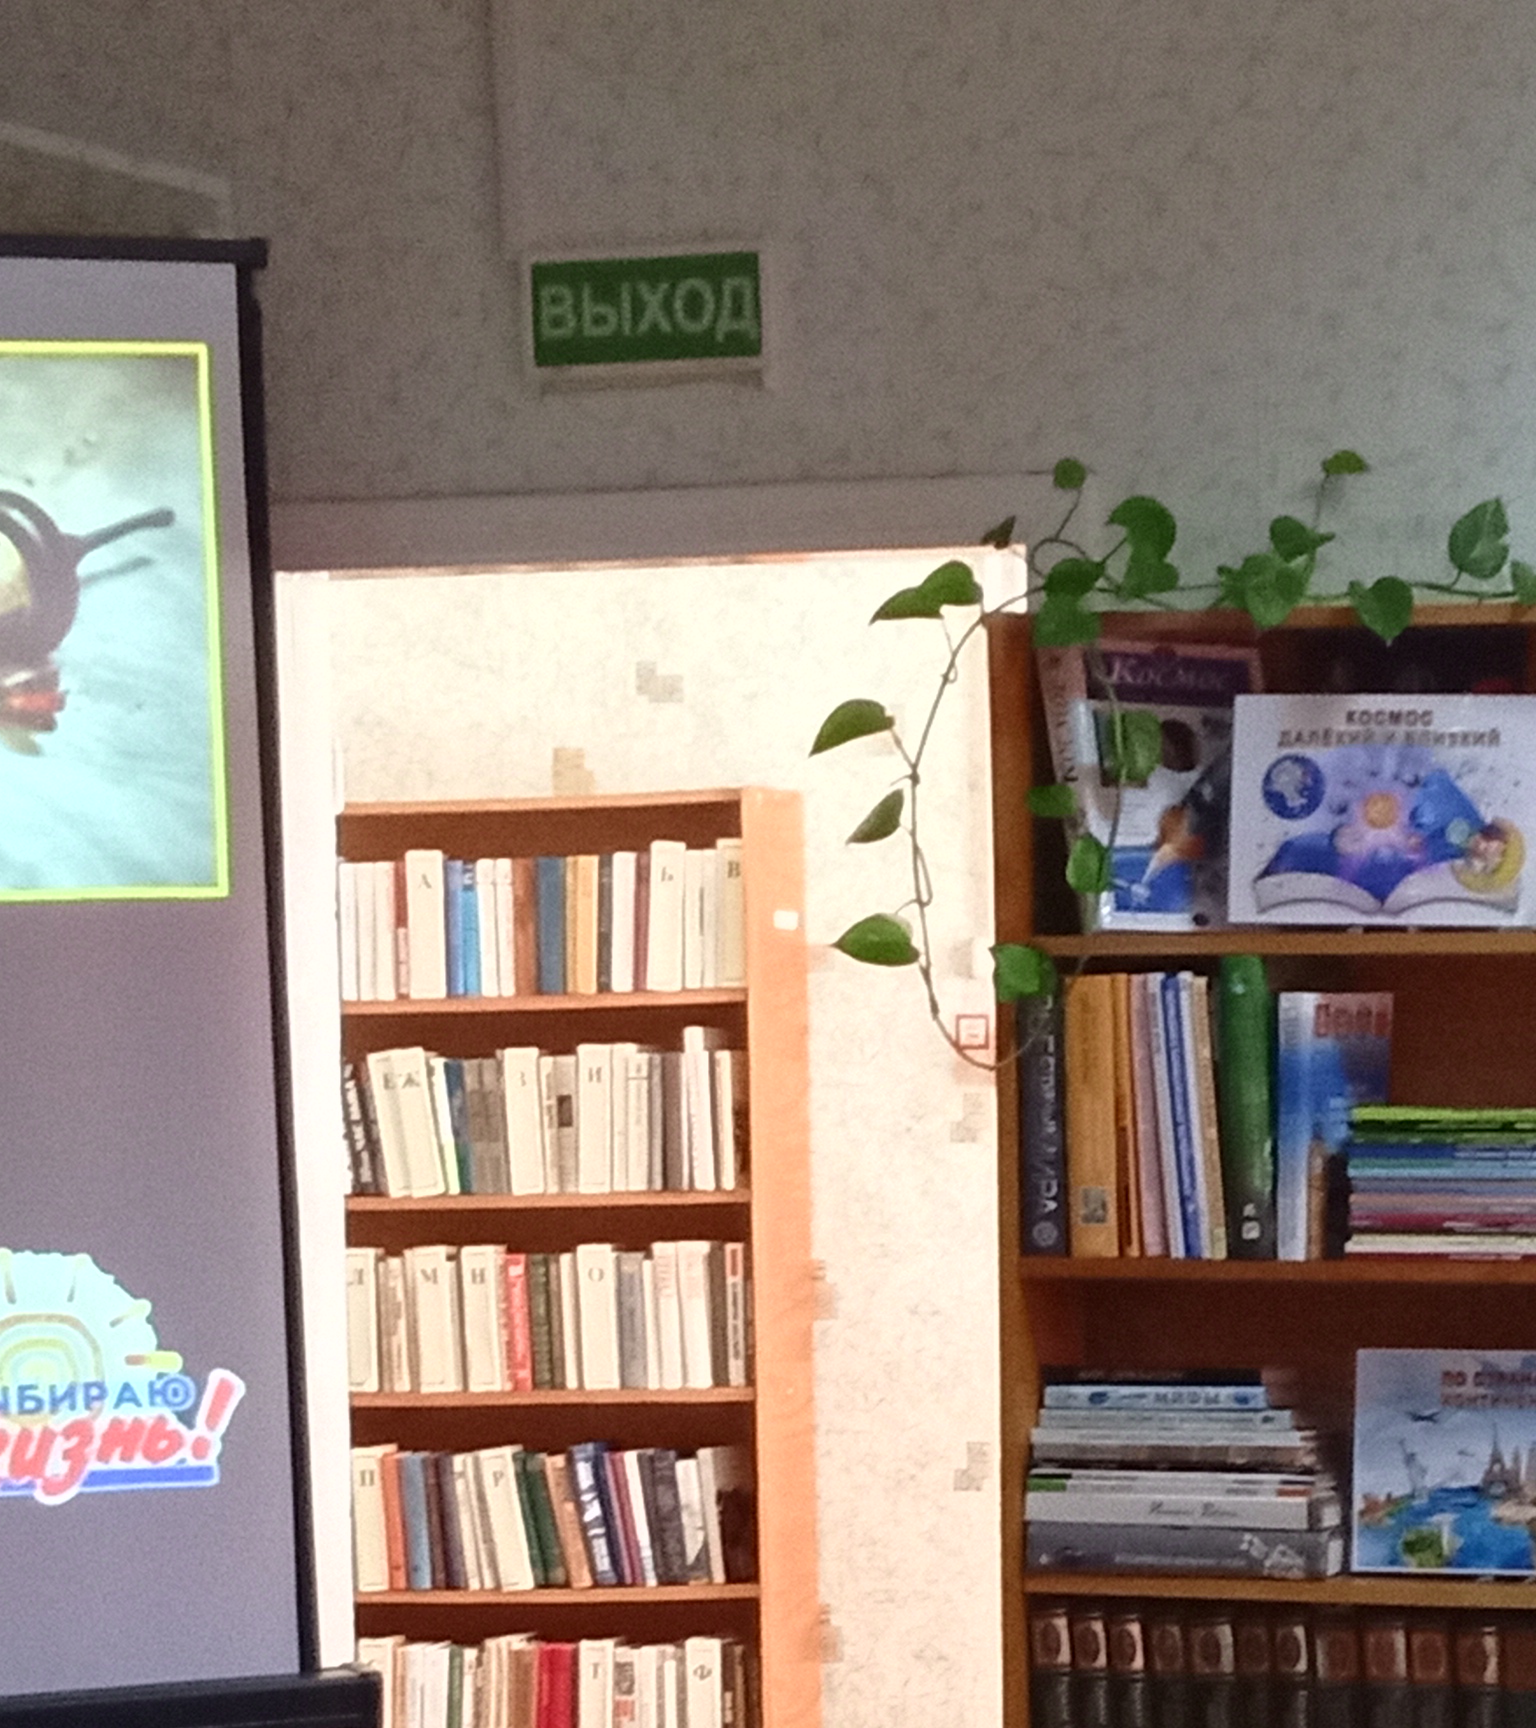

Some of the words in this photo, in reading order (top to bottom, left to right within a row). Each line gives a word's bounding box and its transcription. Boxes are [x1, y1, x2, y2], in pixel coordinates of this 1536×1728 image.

[539, 276, 759, 342] ВЫХОД
[1345, 709, 1434, 727] КОСМОС
[1277, 727, 1375, 748] ДАЛЁКИЙ
[1404, 728, 1501, 748] БЛИЗКИЙ
